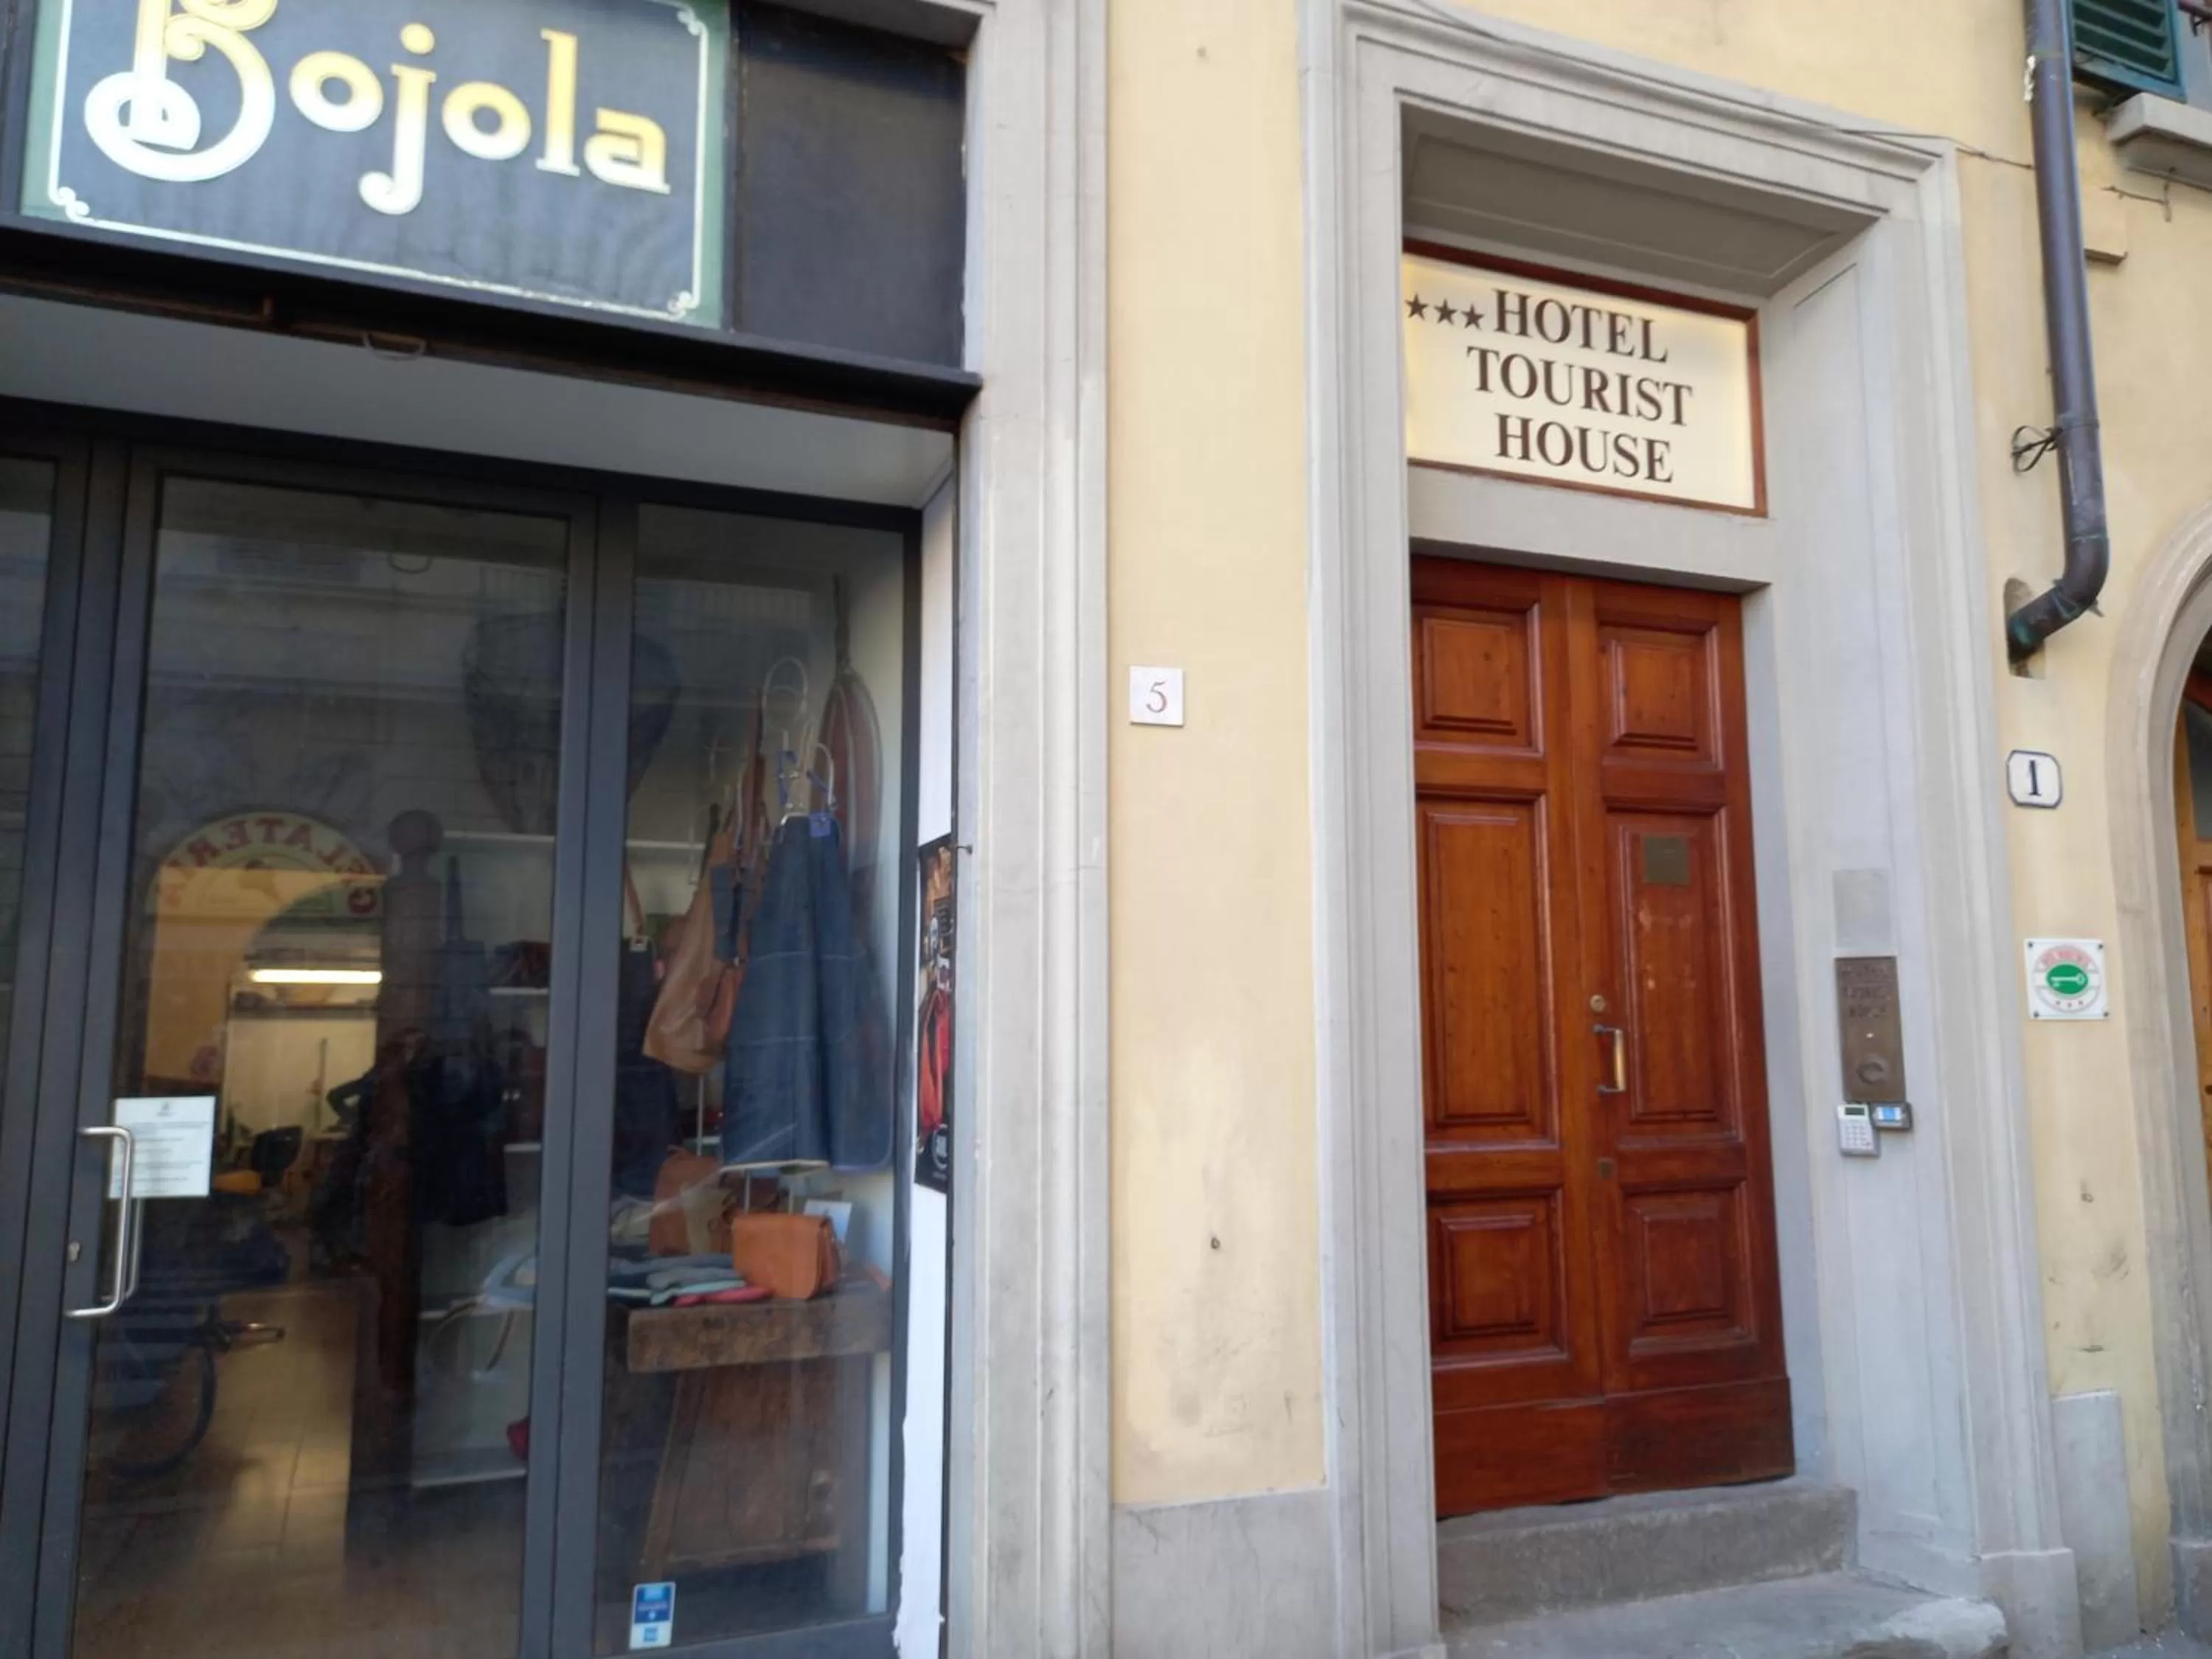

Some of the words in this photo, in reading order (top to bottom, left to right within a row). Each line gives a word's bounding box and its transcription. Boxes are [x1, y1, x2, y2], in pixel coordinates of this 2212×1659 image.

[84, 0, 671, 215] Bojola
[1493, 288, 1669, 364] HOTEL
[1466, 345, 1694, 426] TOURIST
[1494, 413, 1674, 484] HOUSE
[1145, 679, 1168, 714] 5
